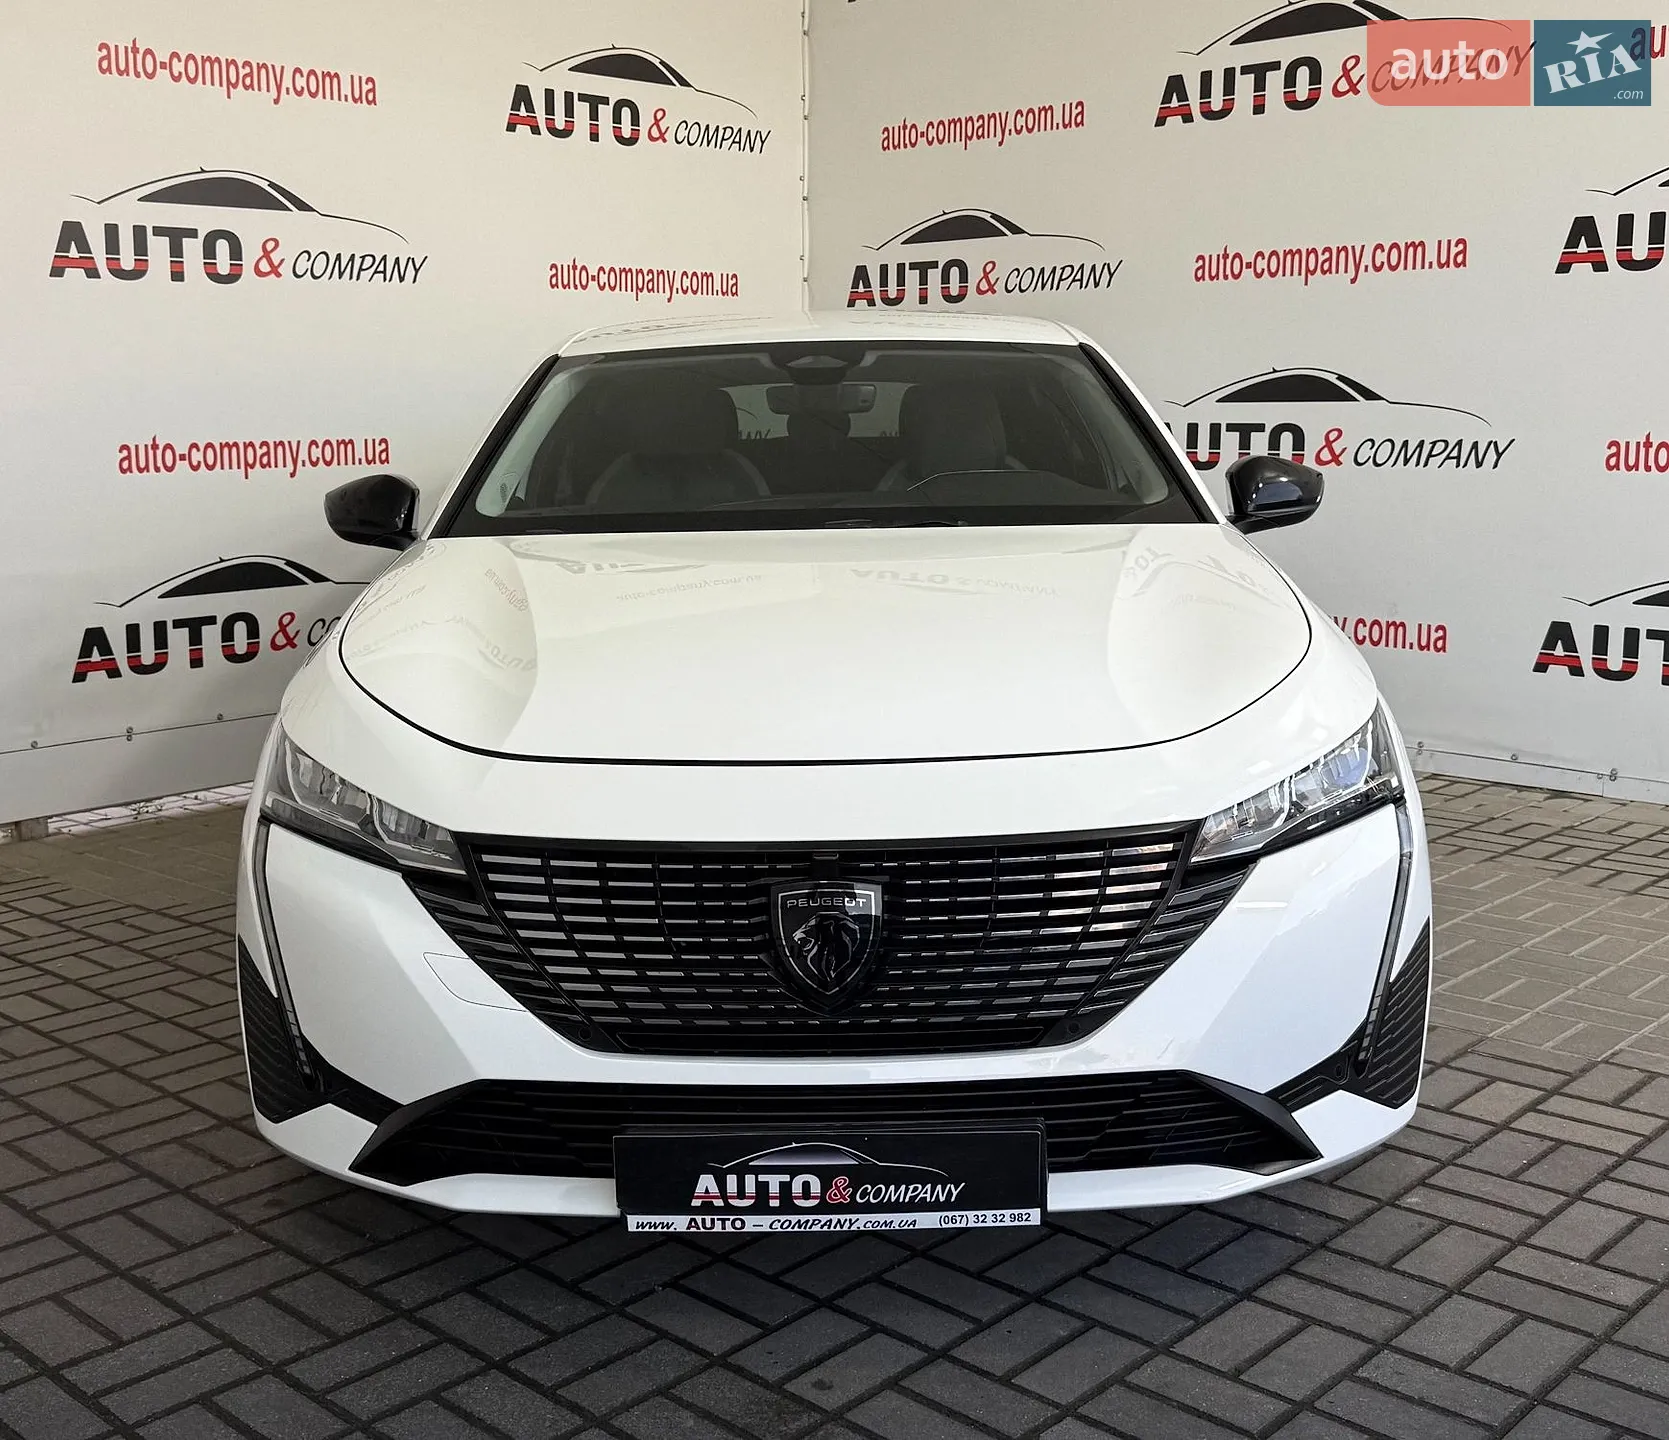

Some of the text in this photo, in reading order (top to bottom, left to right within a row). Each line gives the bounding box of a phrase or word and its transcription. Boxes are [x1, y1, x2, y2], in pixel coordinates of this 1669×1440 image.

[97, 39, 378, 106] auto-company.com.ua
[1155, 54, 1322, 128] AUTO
[1330, 53, 1365, 99] &
[506, 84, 772, 155] AUTO & COMPANY
[880, 98, 1086, 152] auto-company.com.ua
[50, 220, 428, 285] AUTO & COMPANY
[1193, 236, 1468, 286] auto-company.com.ua
[1555, 211, 1667, 274] AU
[549, 257, 739, 302] auto-company.com.ua
[847, 258, 1123, 308] AUTO & COMPANY
[118, 434, 391, 479] auto-company.com.ua
[1164, 422, 1516, 471] UTO & COMPANY
[72, 611, 260, 684] AUTO
[270, 611, 300, 652] &
[786, 897, 867, 909] PEUGEOT
[691, 1174, 966, 1208] AUTO & COMPANY
[686, 1217, 746, 1231] AUTO
[938, 1214, 970, 1227] (067)
[973, 1213, 988, 1224] 32
[991, 1213, 1006, 1223] 32
[1009, 1212, 1032, 1223] 982
